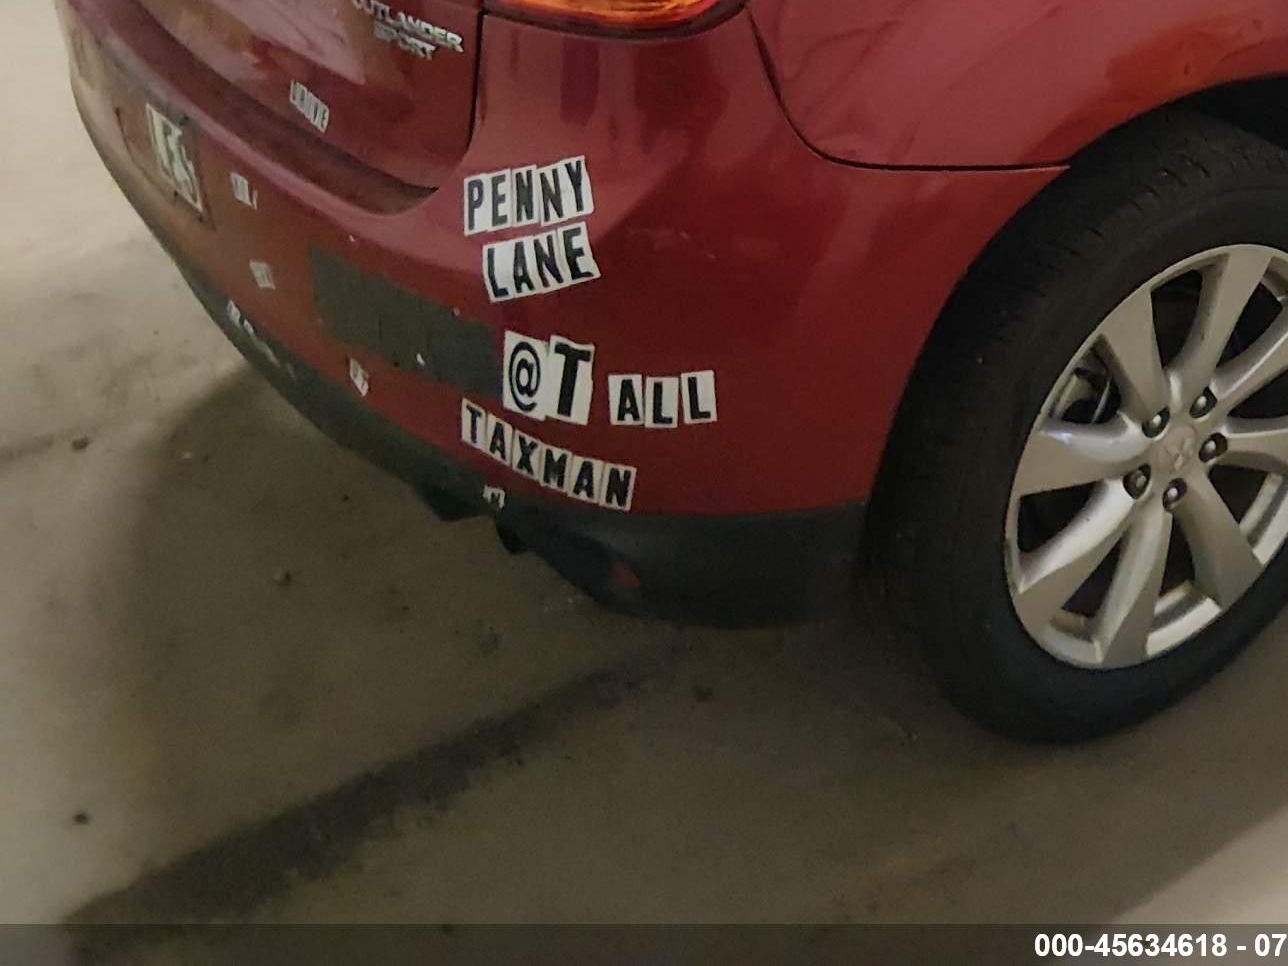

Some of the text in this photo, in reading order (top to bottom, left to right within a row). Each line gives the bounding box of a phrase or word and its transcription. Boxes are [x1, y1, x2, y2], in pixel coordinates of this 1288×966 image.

[467, 159, 584, 231] PENNY
[486, 227, 594, 298] LANE
[508, 342, 712, 424] @T ALL
[465, 405, 632, 508] TAXMAN
